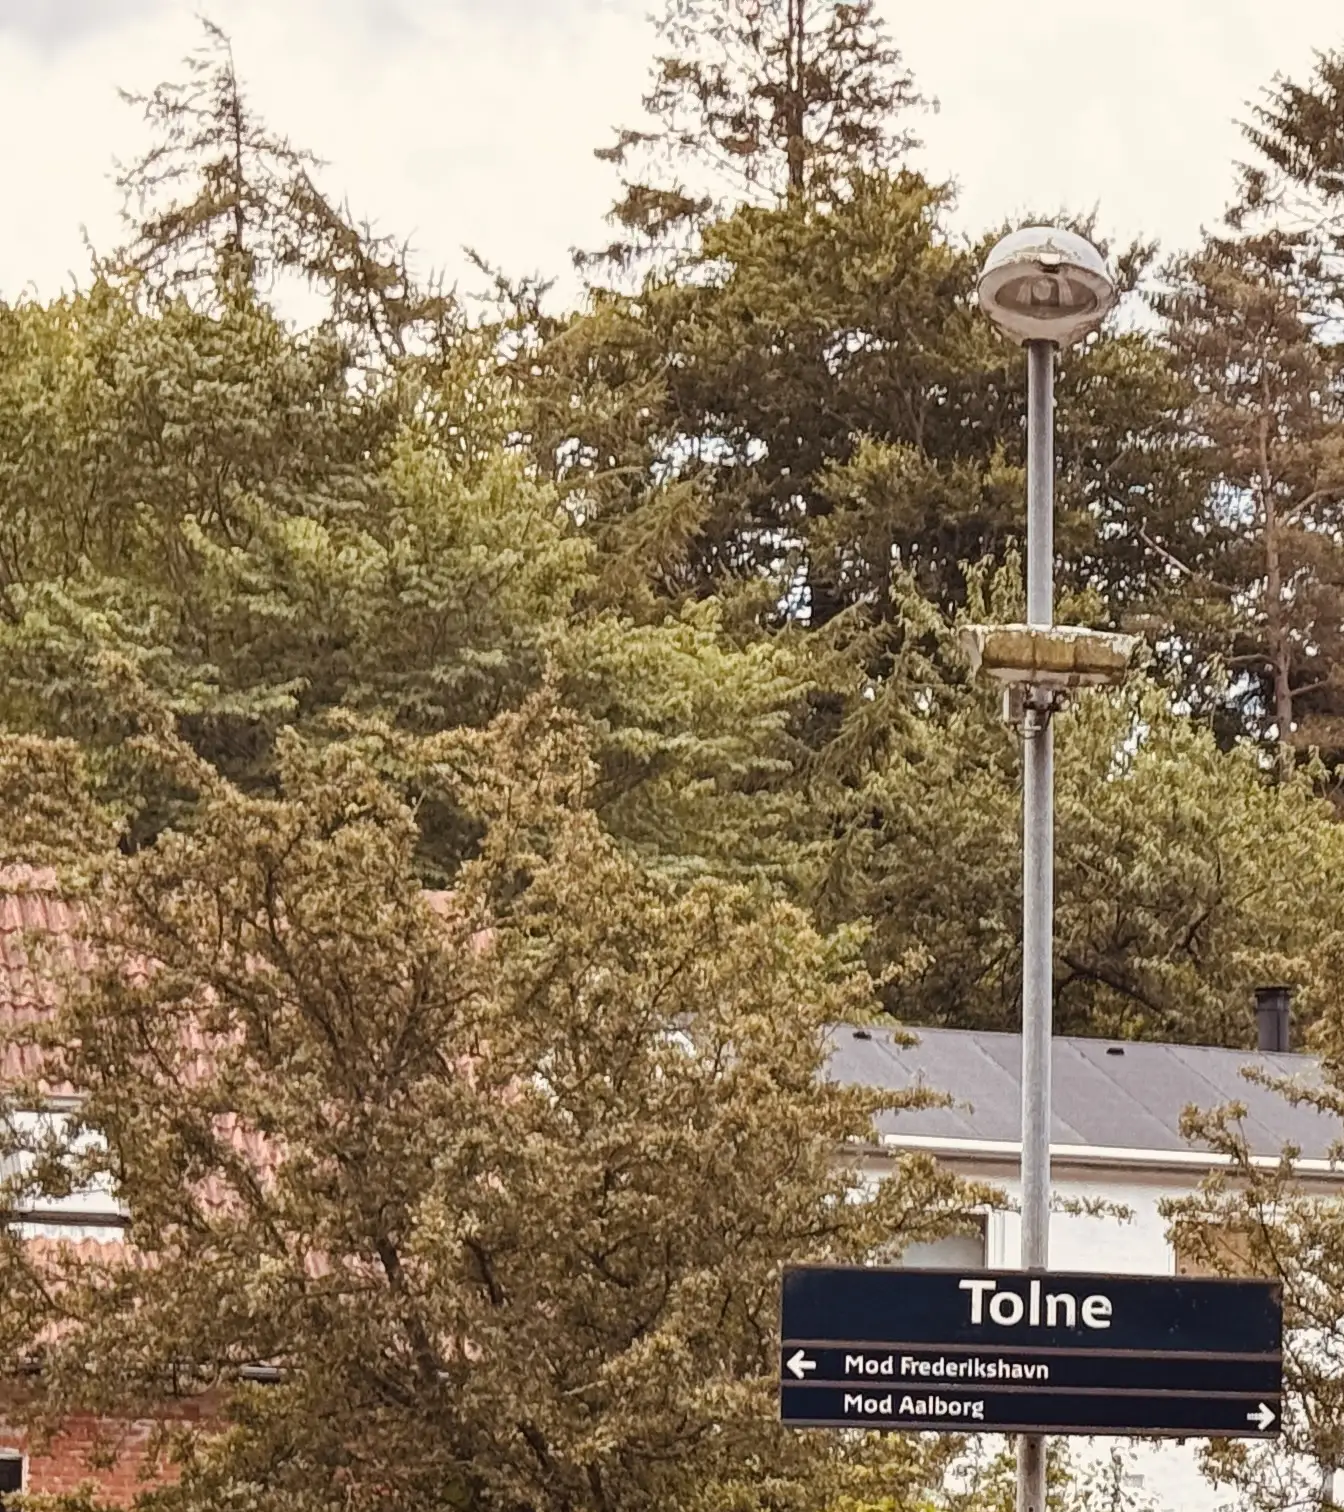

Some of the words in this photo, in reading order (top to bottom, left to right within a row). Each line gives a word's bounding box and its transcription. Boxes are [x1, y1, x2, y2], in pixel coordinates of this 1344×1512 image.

[958, 1279, 1113, 1329] Tolne
[844, 1354, 894, 1375] Mod
[900, 1356, 1050, 1380] Frederikshavn
[843, 1393, 893, 1415] Mod
[898, 1395, 985, 1421] Aalborg
